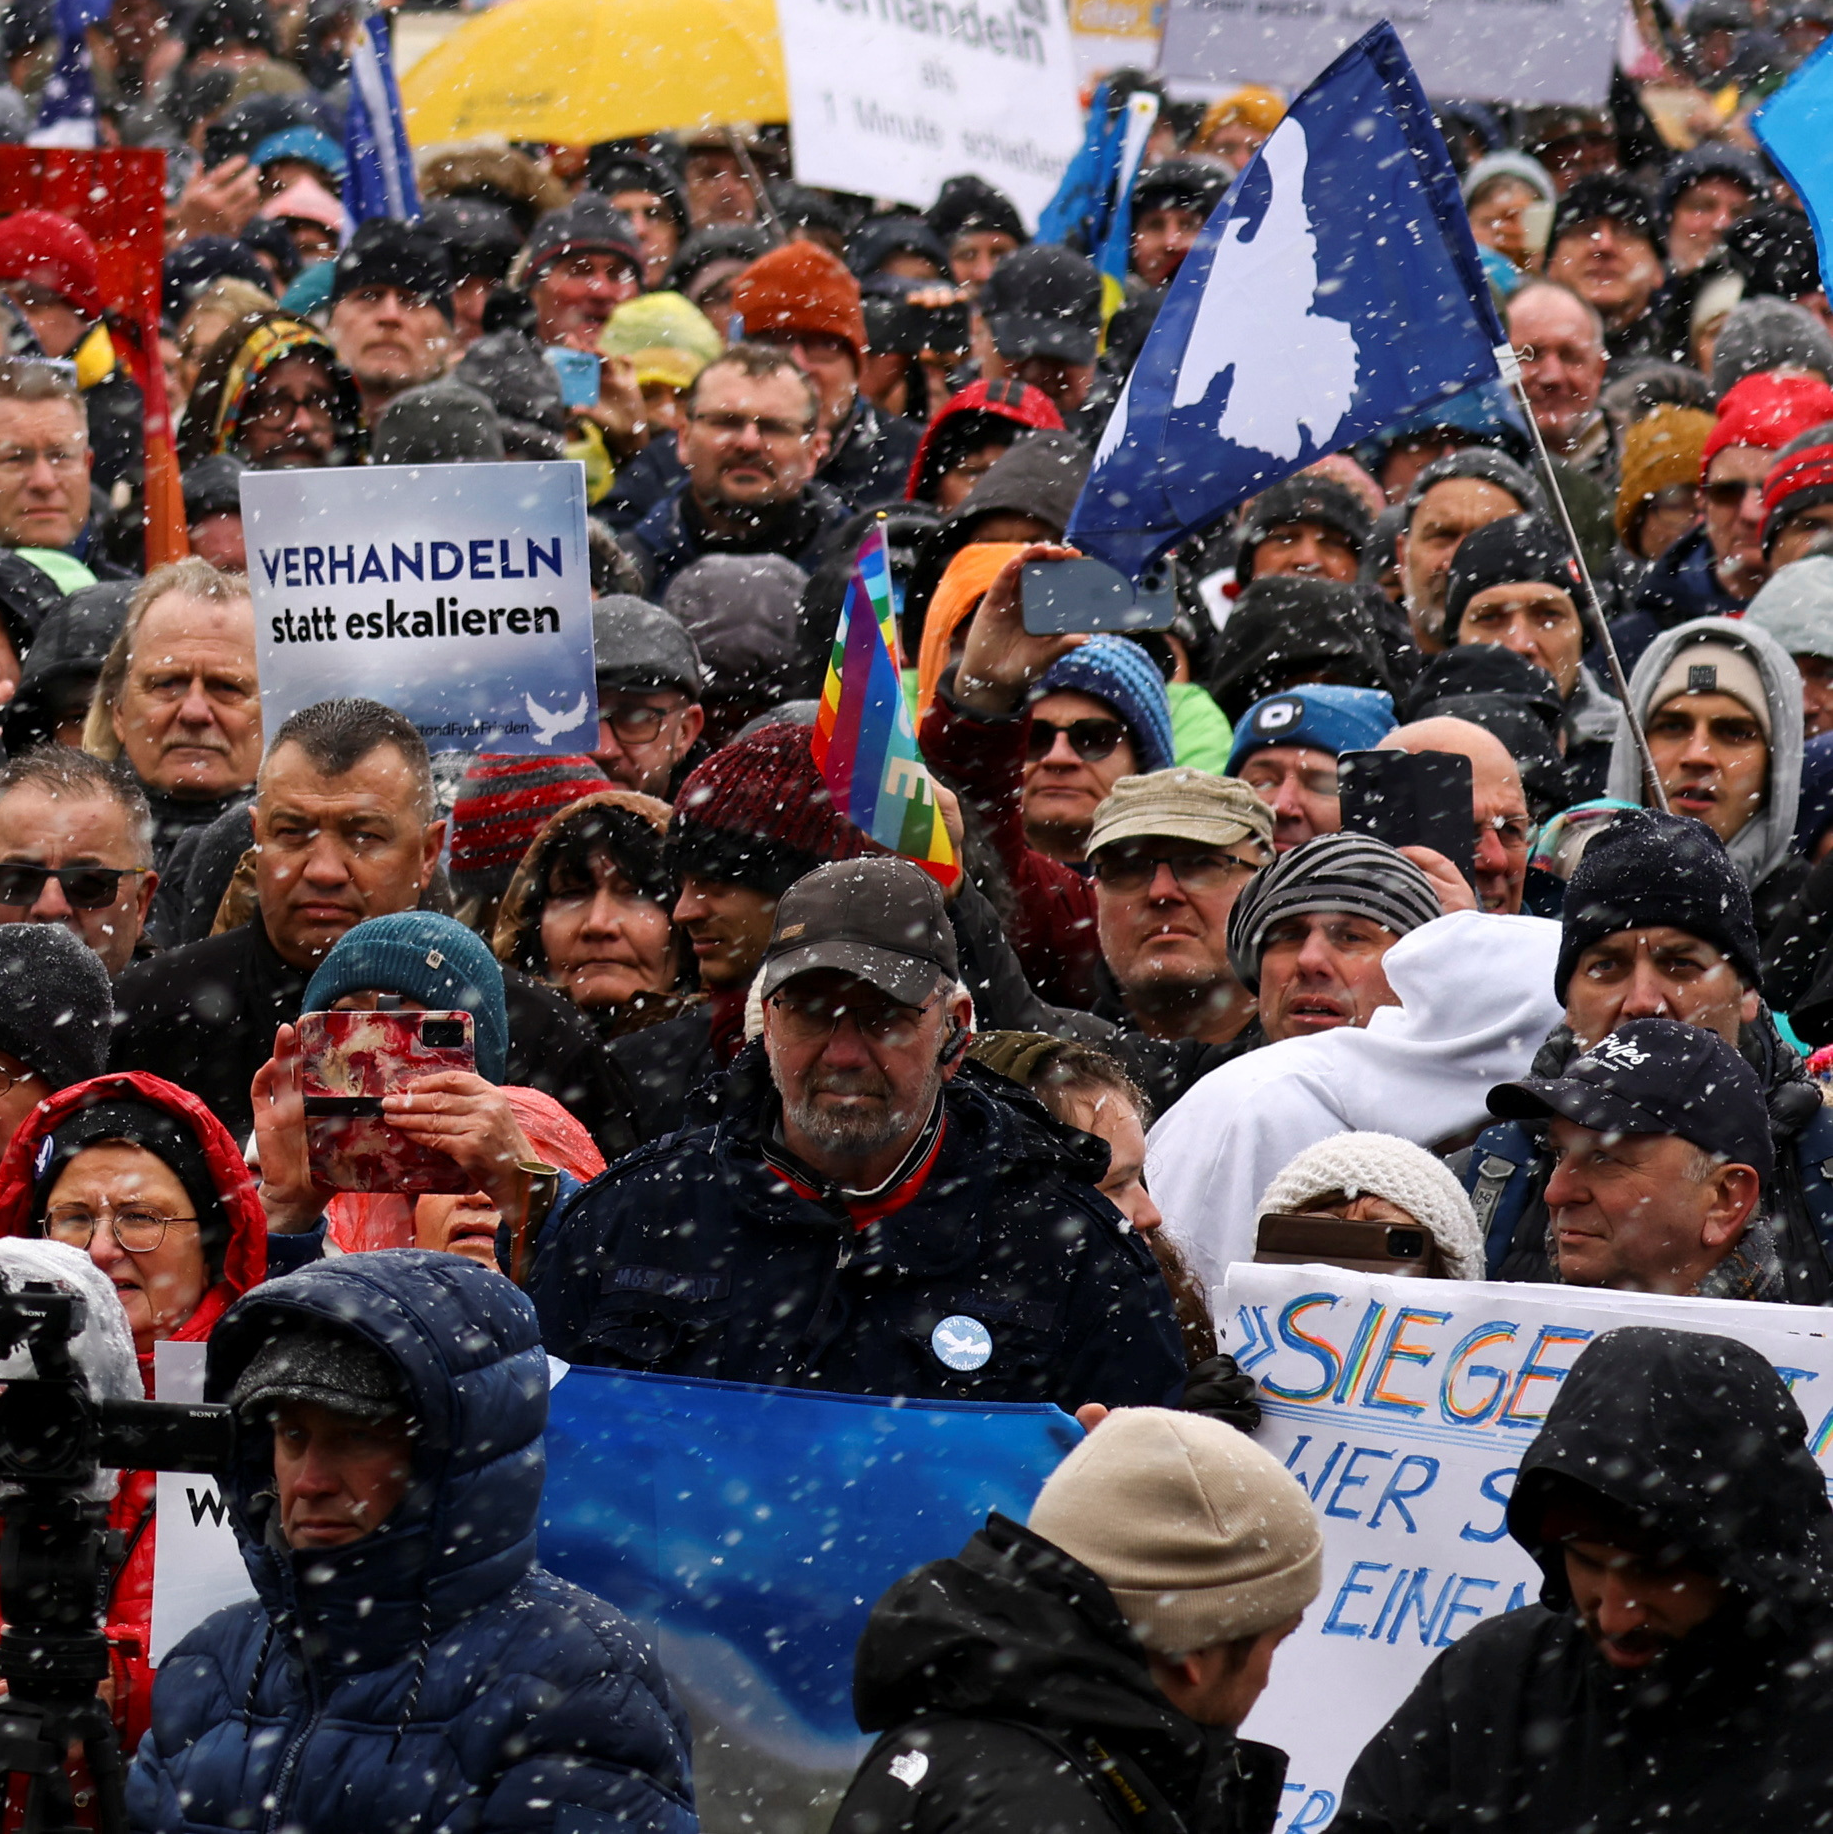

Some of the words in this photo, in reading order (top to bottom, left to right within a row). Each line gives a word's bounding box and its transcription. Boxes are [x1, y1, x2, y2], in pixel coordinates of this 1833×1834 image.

[259, 537, 564, 588] VERHANDELN
[272, 605, 339, 644] statt
[346, 597, 561, 640] eskalieren
[20, 1309, 48, 1318] SONY
[942, 1317, 960, 1329] Ich
[964, 1320, 985, 1333] will
[942, 1354, 982, 1371] Frieden!
[188, 1410, 219, 1419] SONY
